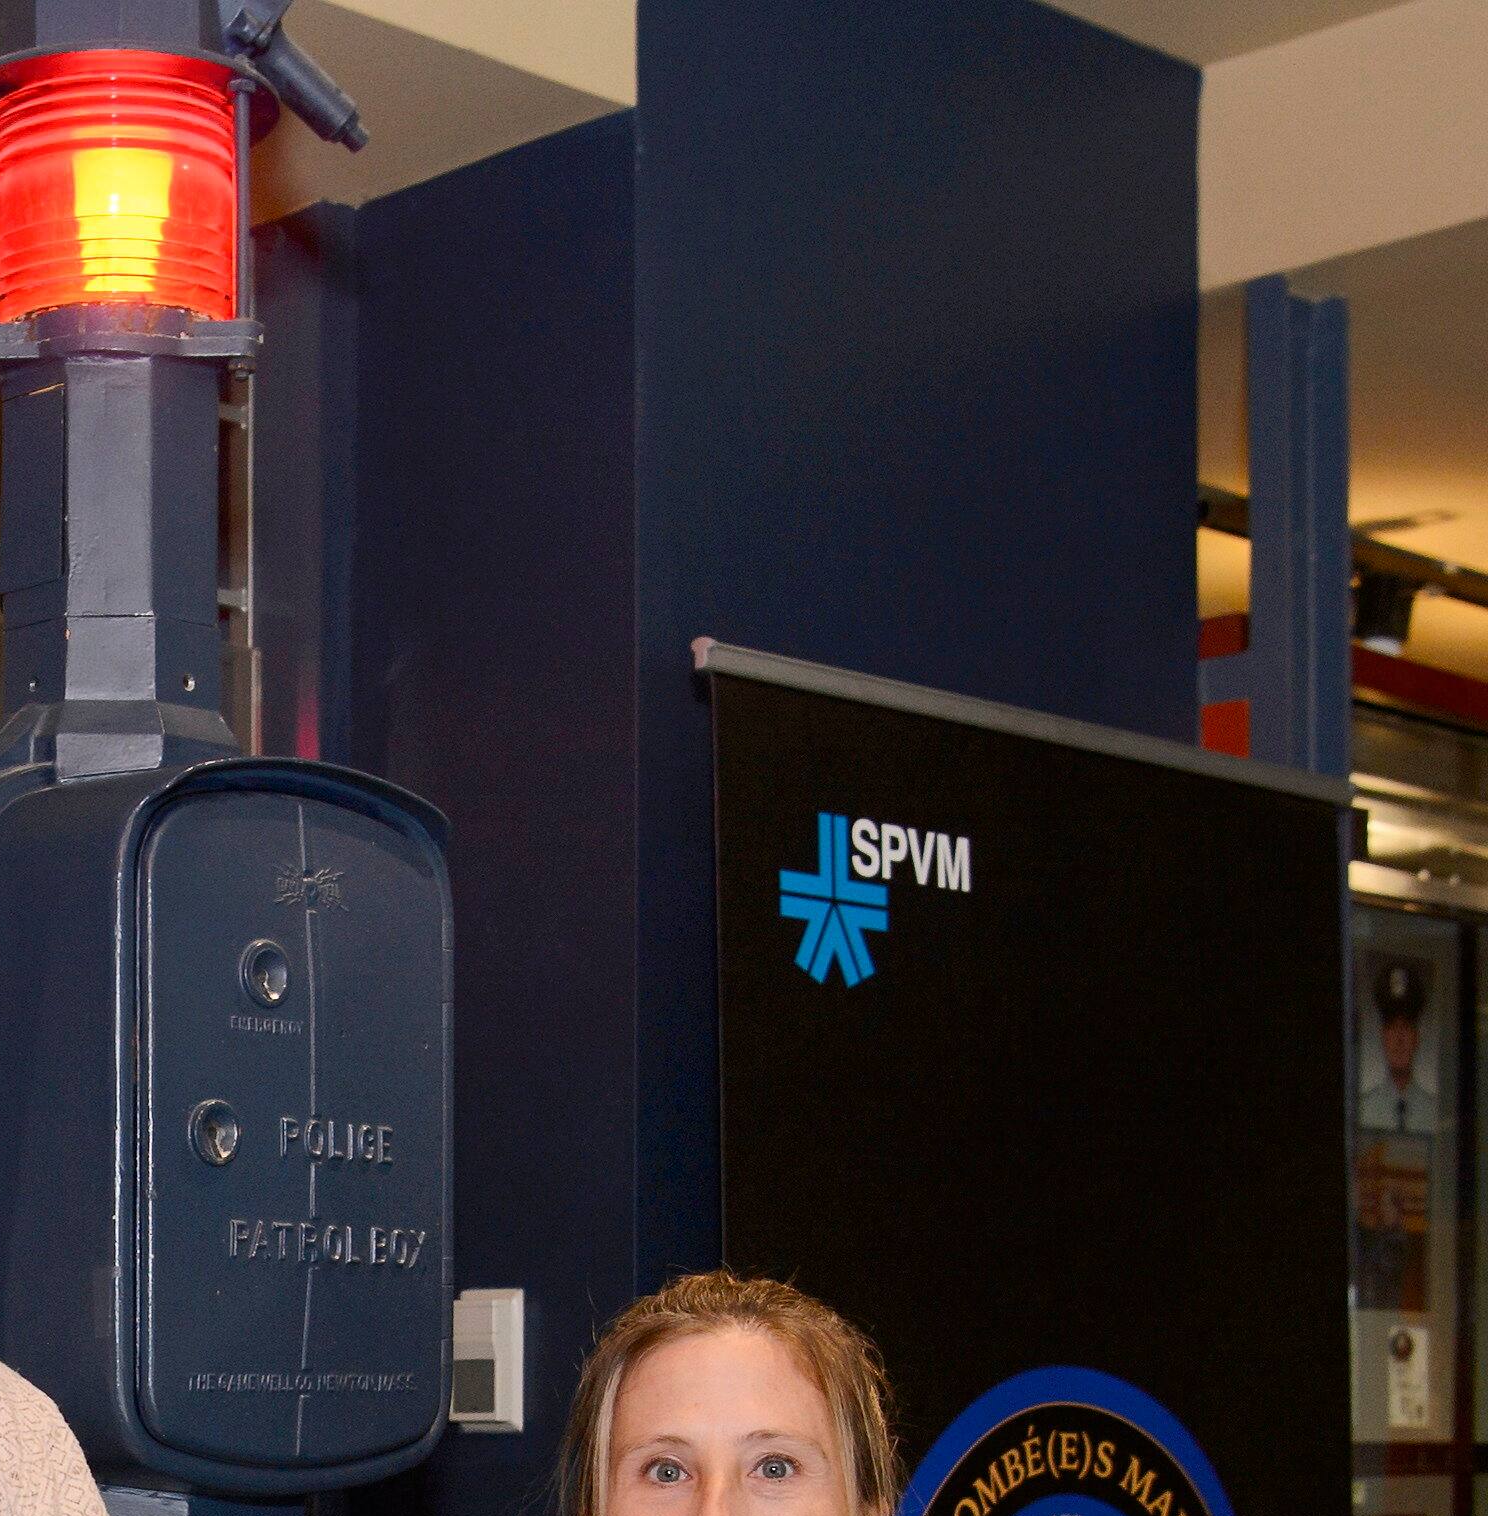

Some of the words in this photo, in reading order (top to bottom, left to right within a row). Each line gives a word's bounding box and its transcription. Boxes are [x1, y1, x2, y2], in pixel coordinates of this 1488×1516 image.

[851, 818, 971, 893] SPVM
[280, 1117, 393, 1163] POLICE
[230, 1219, 361, 1264] PATROL
[370, 1227, 426, 1268] BOX
